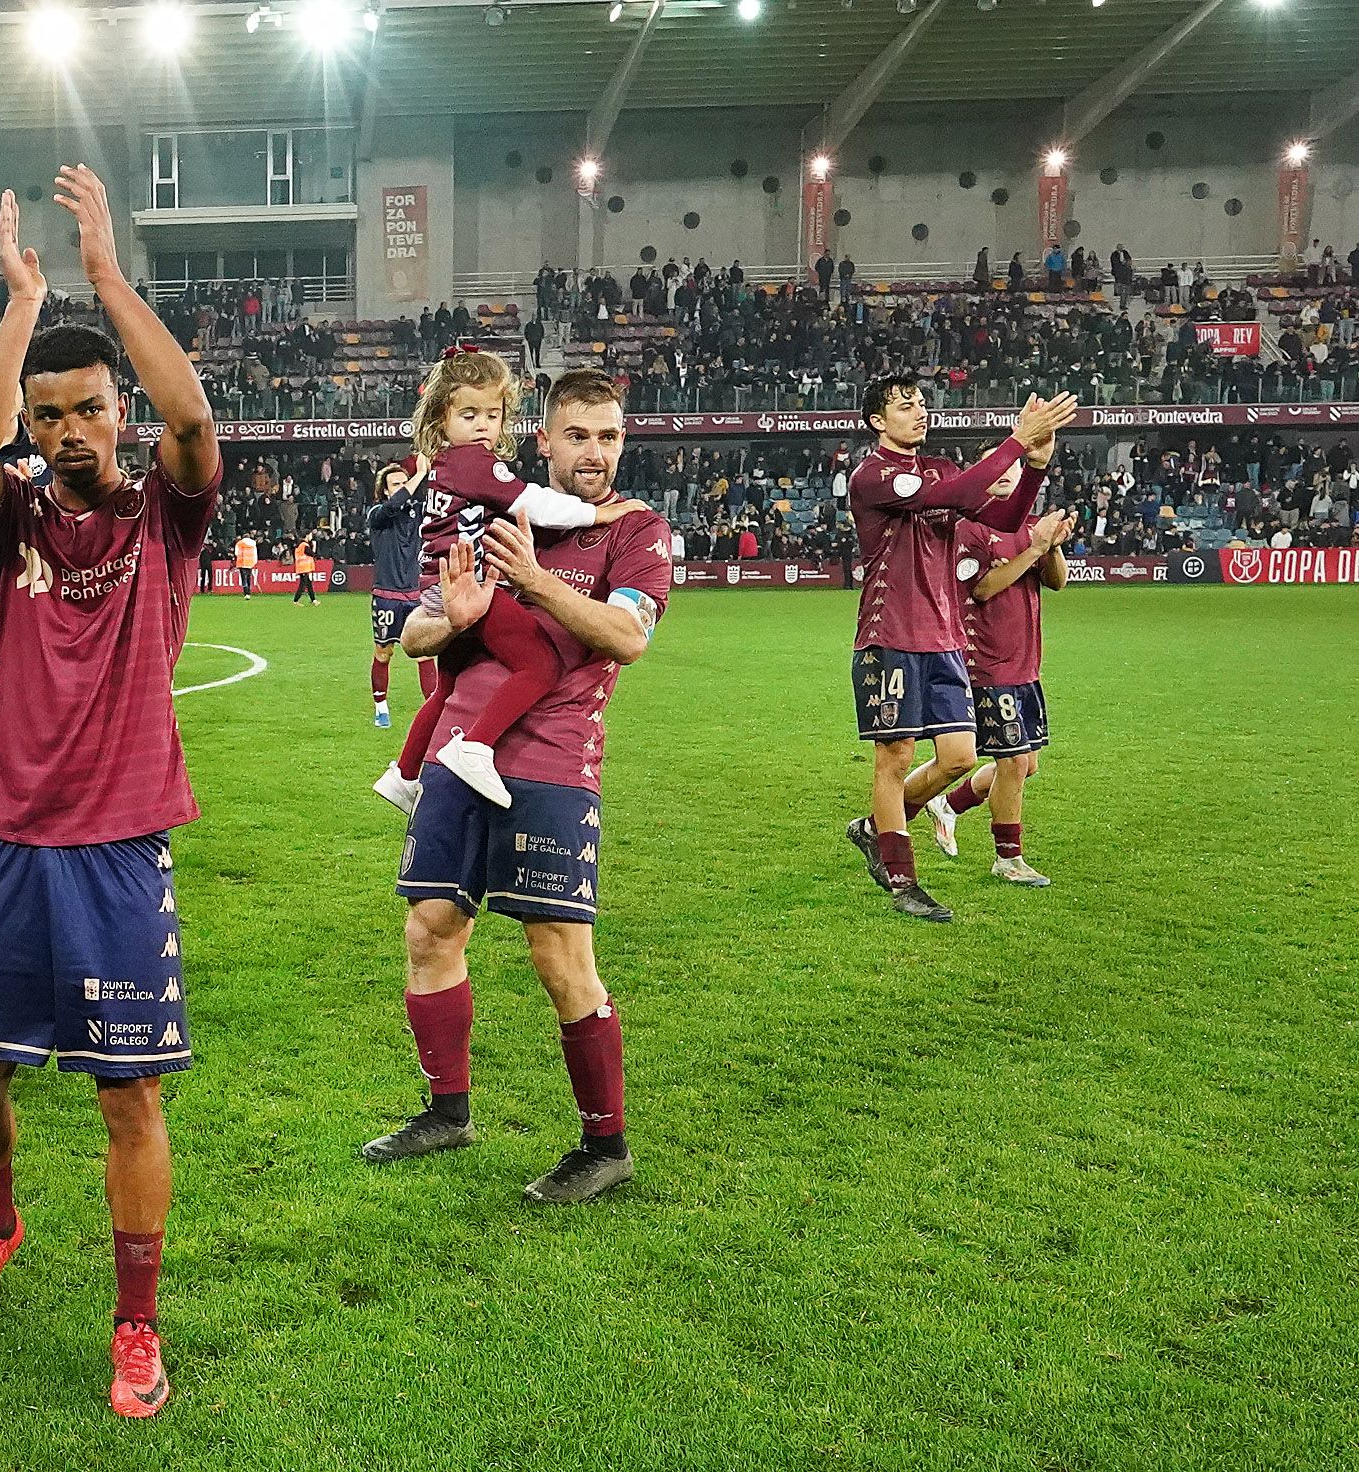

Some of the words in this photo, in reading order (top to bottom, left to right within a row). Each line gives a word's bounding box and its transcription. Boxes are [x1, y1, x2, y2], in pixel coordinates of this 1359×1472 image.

[385, 194, 415, 207] FOR
[386, 208, 406, 220] ZA
[386, 220, 417, 233] PON
[387, 233, 424, 246] TEVE
[387, 246, 417, 259] DRA
[1234, 327, 1252, 344] REY
[930, 412, 972, 428] Diario
[986, 411, 1021, 427] Ponte
[1092, 409, 1134, 425] Diario
[1148, 408, 1223, 424] Pontevedra
[137, 425, 164, 438] exa
[239, 423, 285, 435] exalta
[292, 421, 345, 438] Estrella
[348, 420, 396, 437] Galicia
[778, 420, 811, 431] HOTEL
[813, 419, 855, 430] GALICIA
[1066, 559, 1087, 567] RVAS
[1268, 550, 1326, 582] COPA
[1067, 566, 1106, 581] MAR
[377, 610, 394, 626] 20
[880, 668, 905, 701] 14
[998, 693, 1017, 721] 8
[528, 834, 557, 846] XUNTA
[527, 843, 538, 851] DE
[539, 844, 572, 857] GALICIA
[531, 870, 570, 883] DEPORTE
[530, 880, 565, 892] GALEGO
[102, 980, 136, 991] XUNTA
[101, 991, 117, 1000] DE
[117, 990, 155, 1000] GALICIA
[110, 1023, 153, 1034] DEPORTE
[109, 1034, 149, 1046] GALEGO
